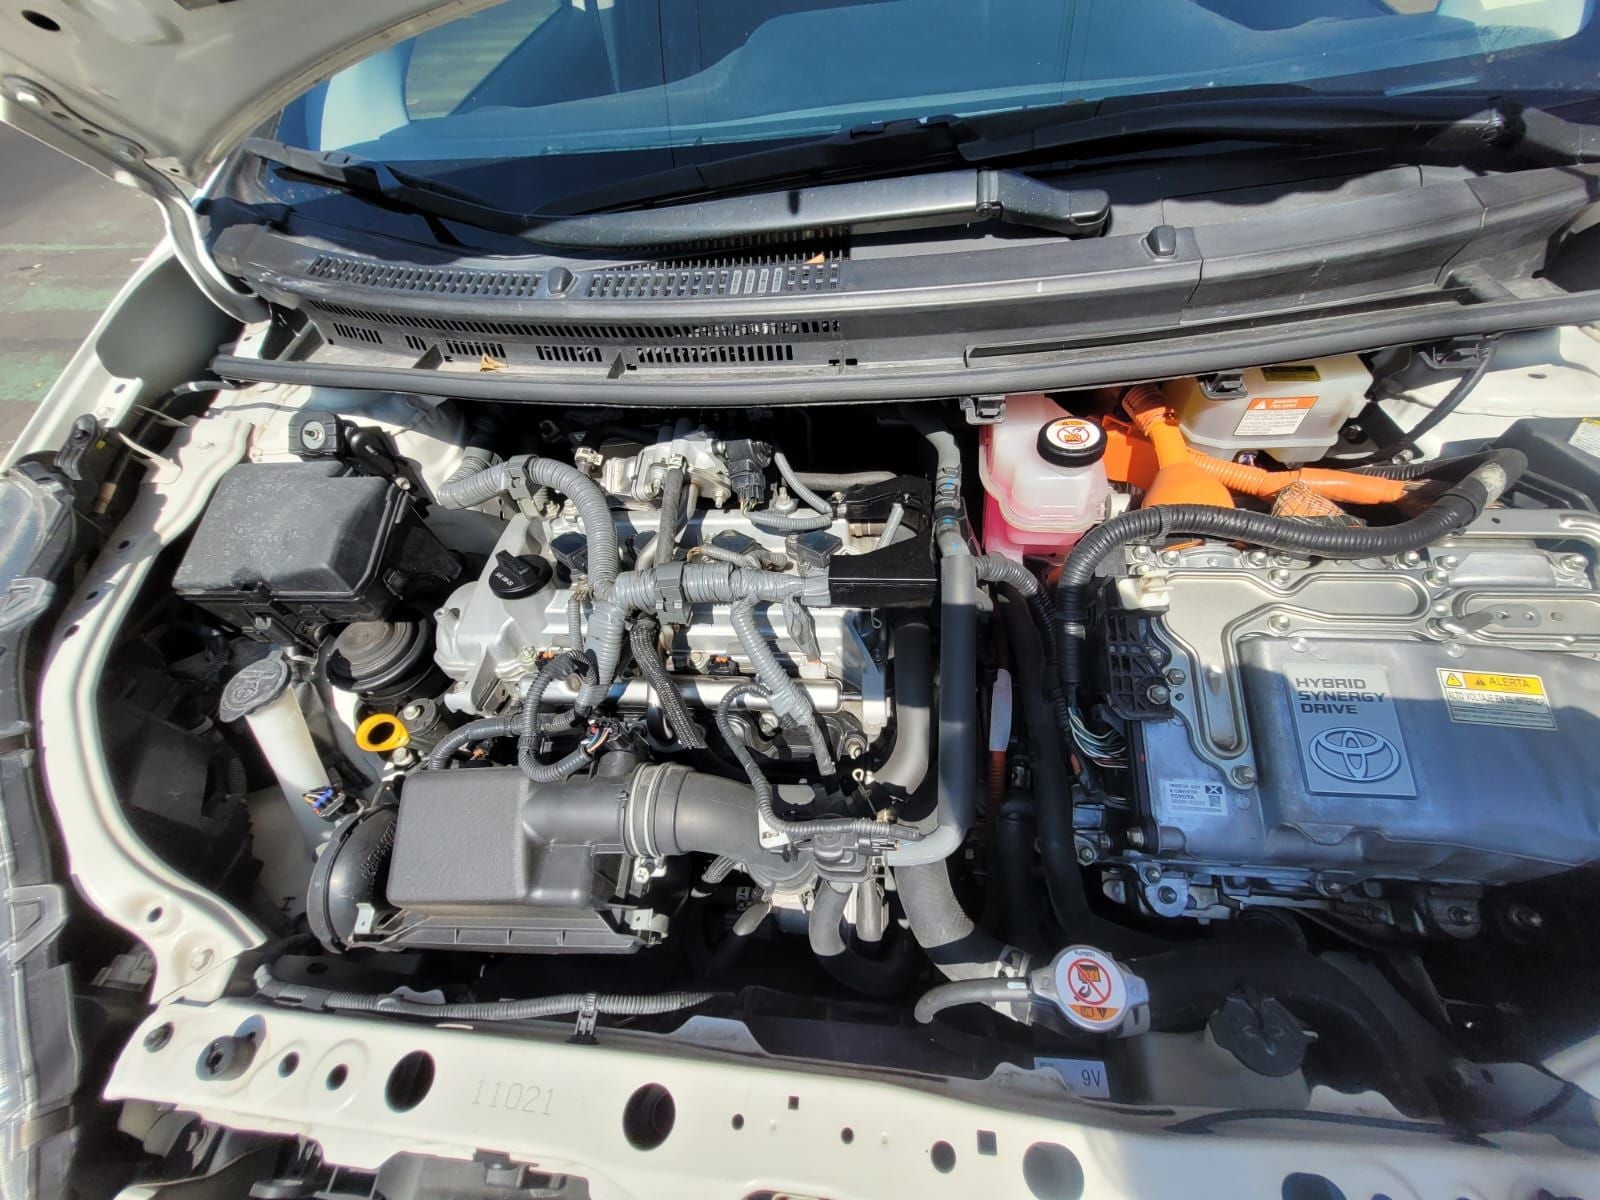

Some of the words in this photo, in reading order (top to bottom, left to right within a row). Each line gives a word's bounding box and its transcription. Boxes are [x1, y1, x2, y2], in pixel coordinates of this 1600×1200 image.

[1295, 678, 1366, 689] HYBRID
[1489, 676, 1530, 688] ALERTA
[1298, 690, 1385, 703] SYNERGY
[1300, 703, 1358, 715] DRIVE
[1081, 1068, 1100, 1087] 9V
[471, 1079, 554, 1116] 11021
